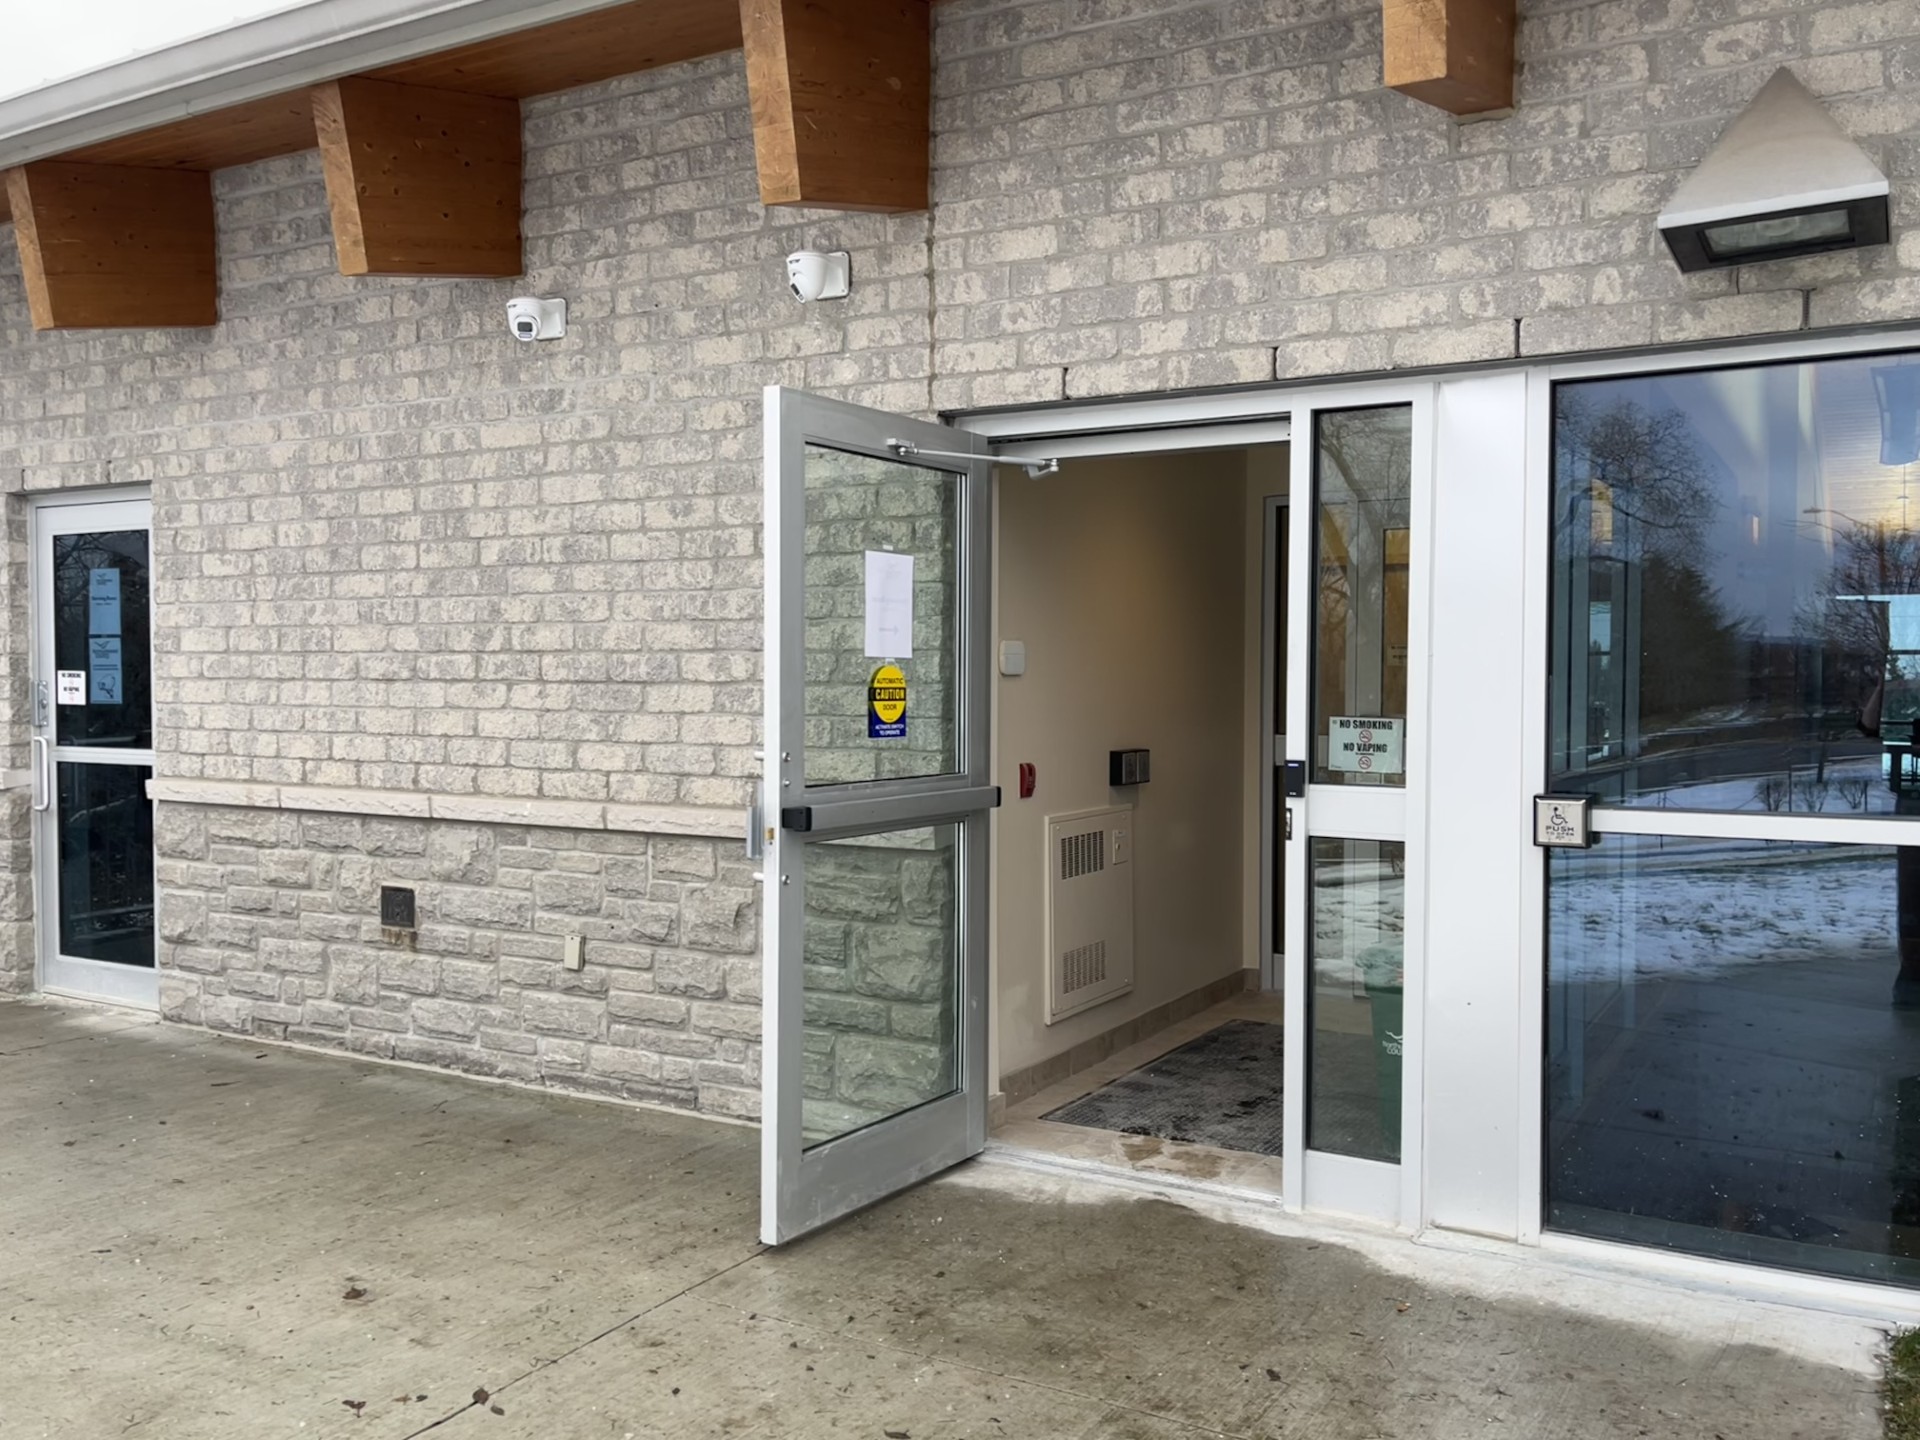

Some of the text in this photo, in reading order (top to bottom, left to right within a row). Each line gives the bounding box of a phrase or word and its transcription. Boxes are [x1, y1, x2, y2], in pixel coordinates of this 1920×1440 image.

[875, 688, 905, 700] CAUTION
[882, 703, 897, 711] DOOR
[1339, 719, 1393, 730] NO SMOKING
[1343, 742, 1388, 753] NO VAPING
